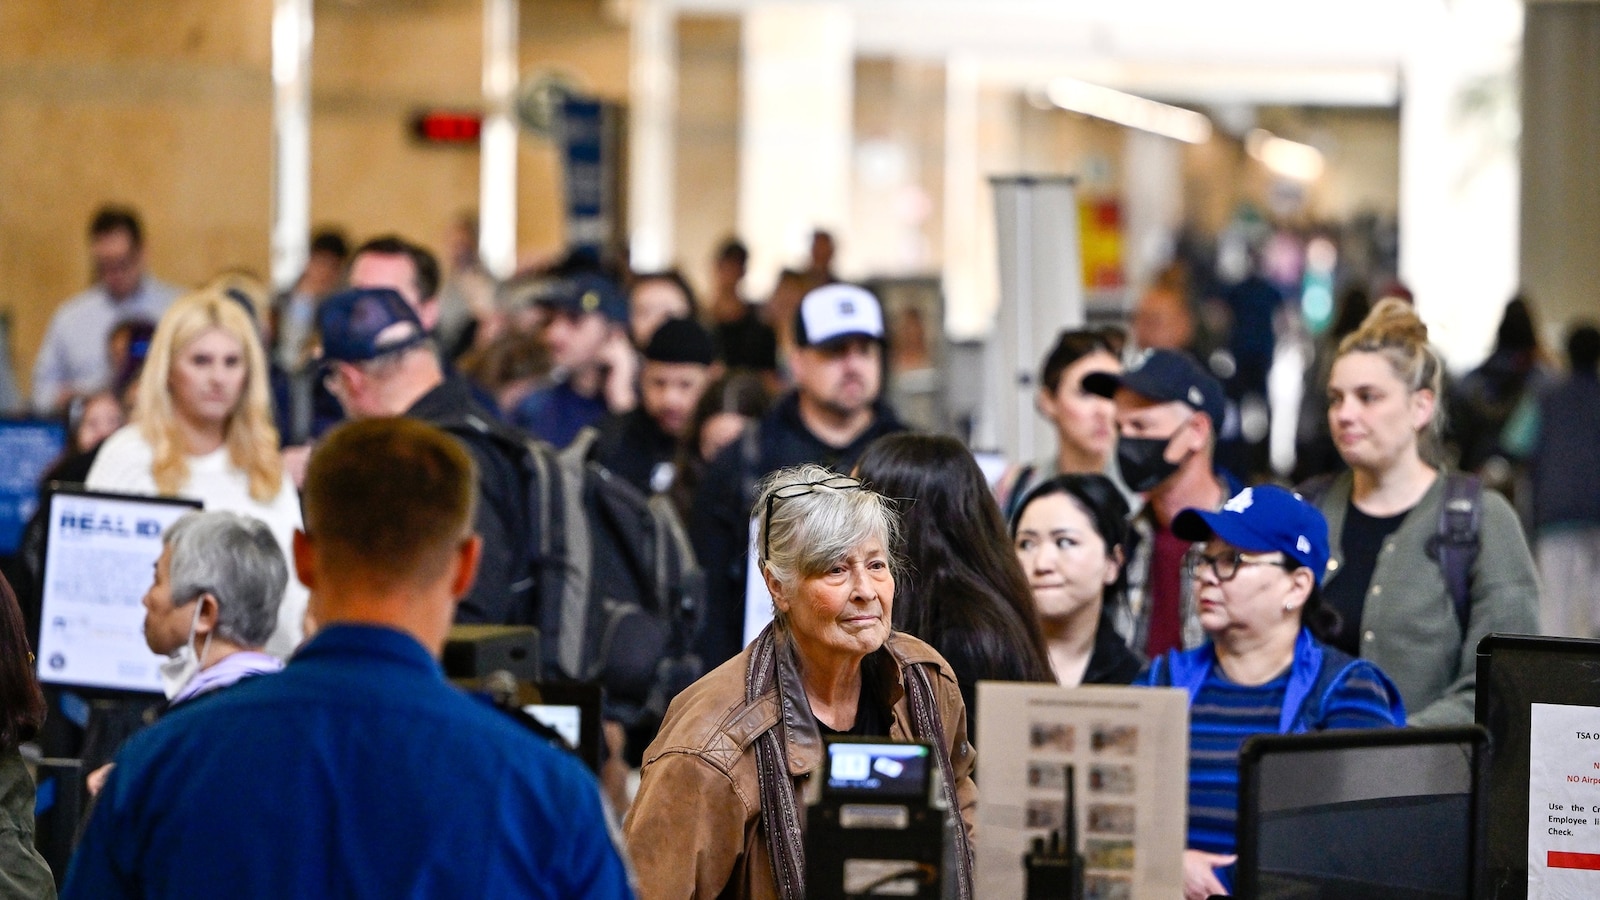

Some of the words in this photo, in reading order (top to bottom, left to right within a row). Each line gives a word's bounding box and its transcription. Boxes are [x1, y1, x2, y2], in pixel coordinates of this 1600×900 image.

[60, 510, 129, 537] REAL
[136, 518, 162, 538] ID
[1576, 731, 1591, 740] TSA
[1567, 775, 1580, 783] NO
[1548, 803, 1564, 811] Use
[1571, 804, 1585, 812] the
[1548, 815, 1587, 826] Employee
[1548, 827, 1574, 837] Check.
